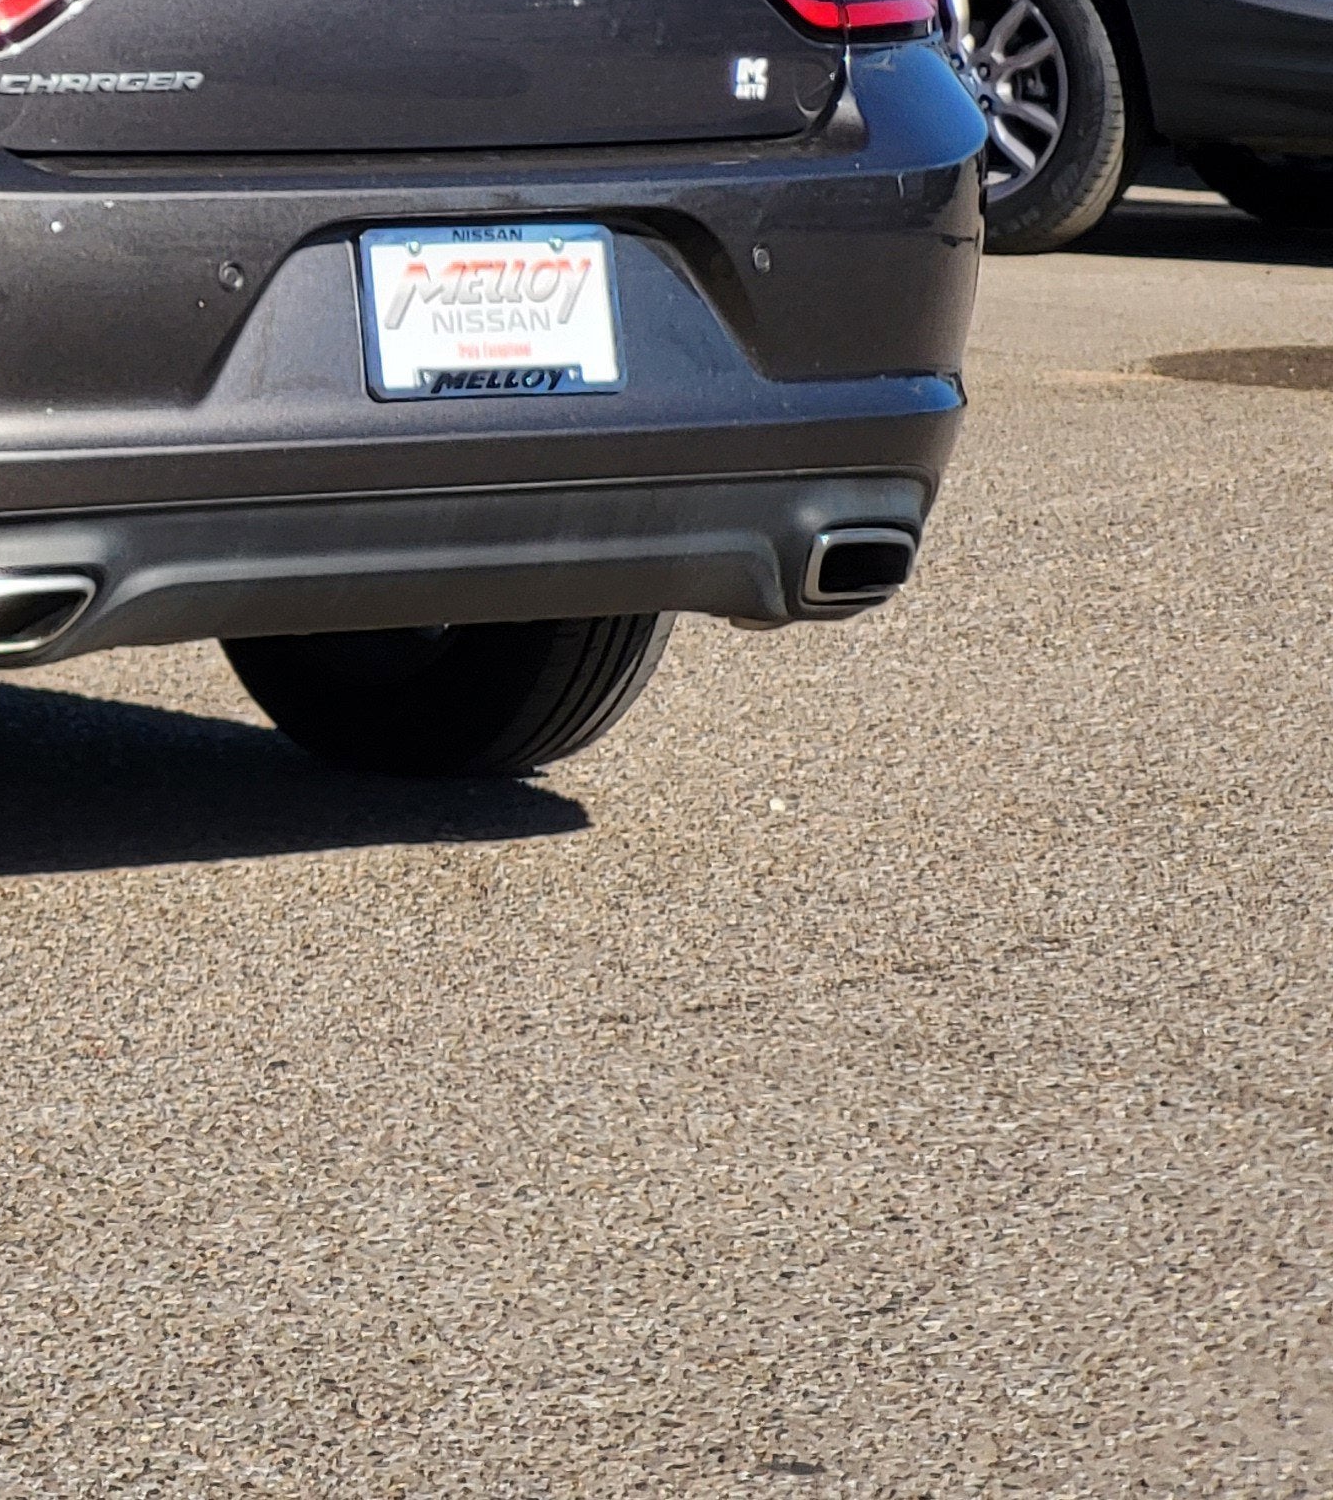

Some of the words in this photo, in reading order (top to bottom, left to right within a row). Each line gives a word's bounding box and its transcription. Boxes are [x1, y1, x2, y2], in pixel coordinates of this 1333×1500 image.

[452, 229, 523, 242] NISSAN
[432, 308, 552, 334] NISSAN
[430, 368, 565, 394] MELLOY
